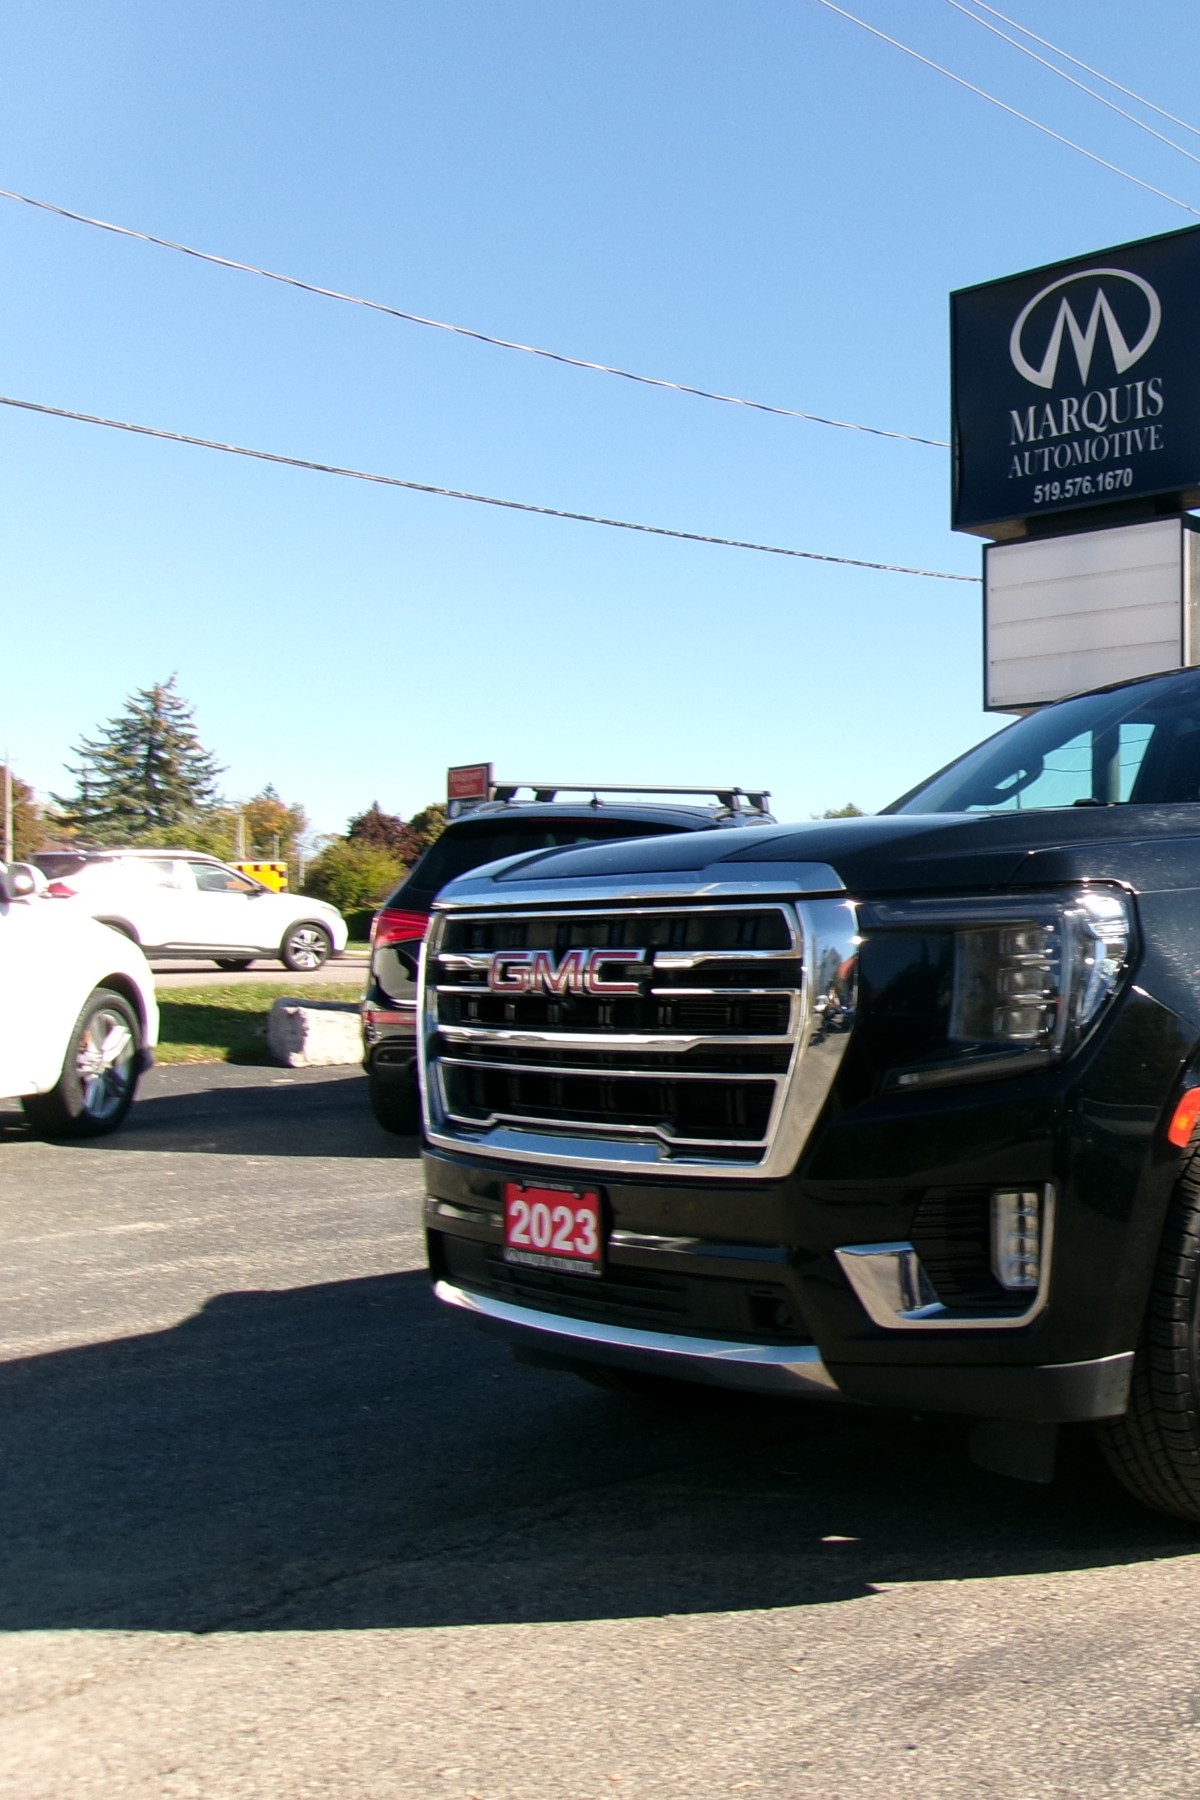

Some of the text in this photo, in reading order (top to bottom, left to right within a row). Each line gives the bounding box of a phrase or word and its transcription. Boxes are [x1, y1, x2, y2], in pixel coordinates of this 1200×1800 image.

[1009, 377, 1164, 446] MARQUIS
[1008, 424, 1164, 478] AUTOMOTIVE
[1034, 468, 1133, 504] 519.576.1670
[487, 947, 647, 996] GMC
[509, 1200, 599, 1255] 2023
